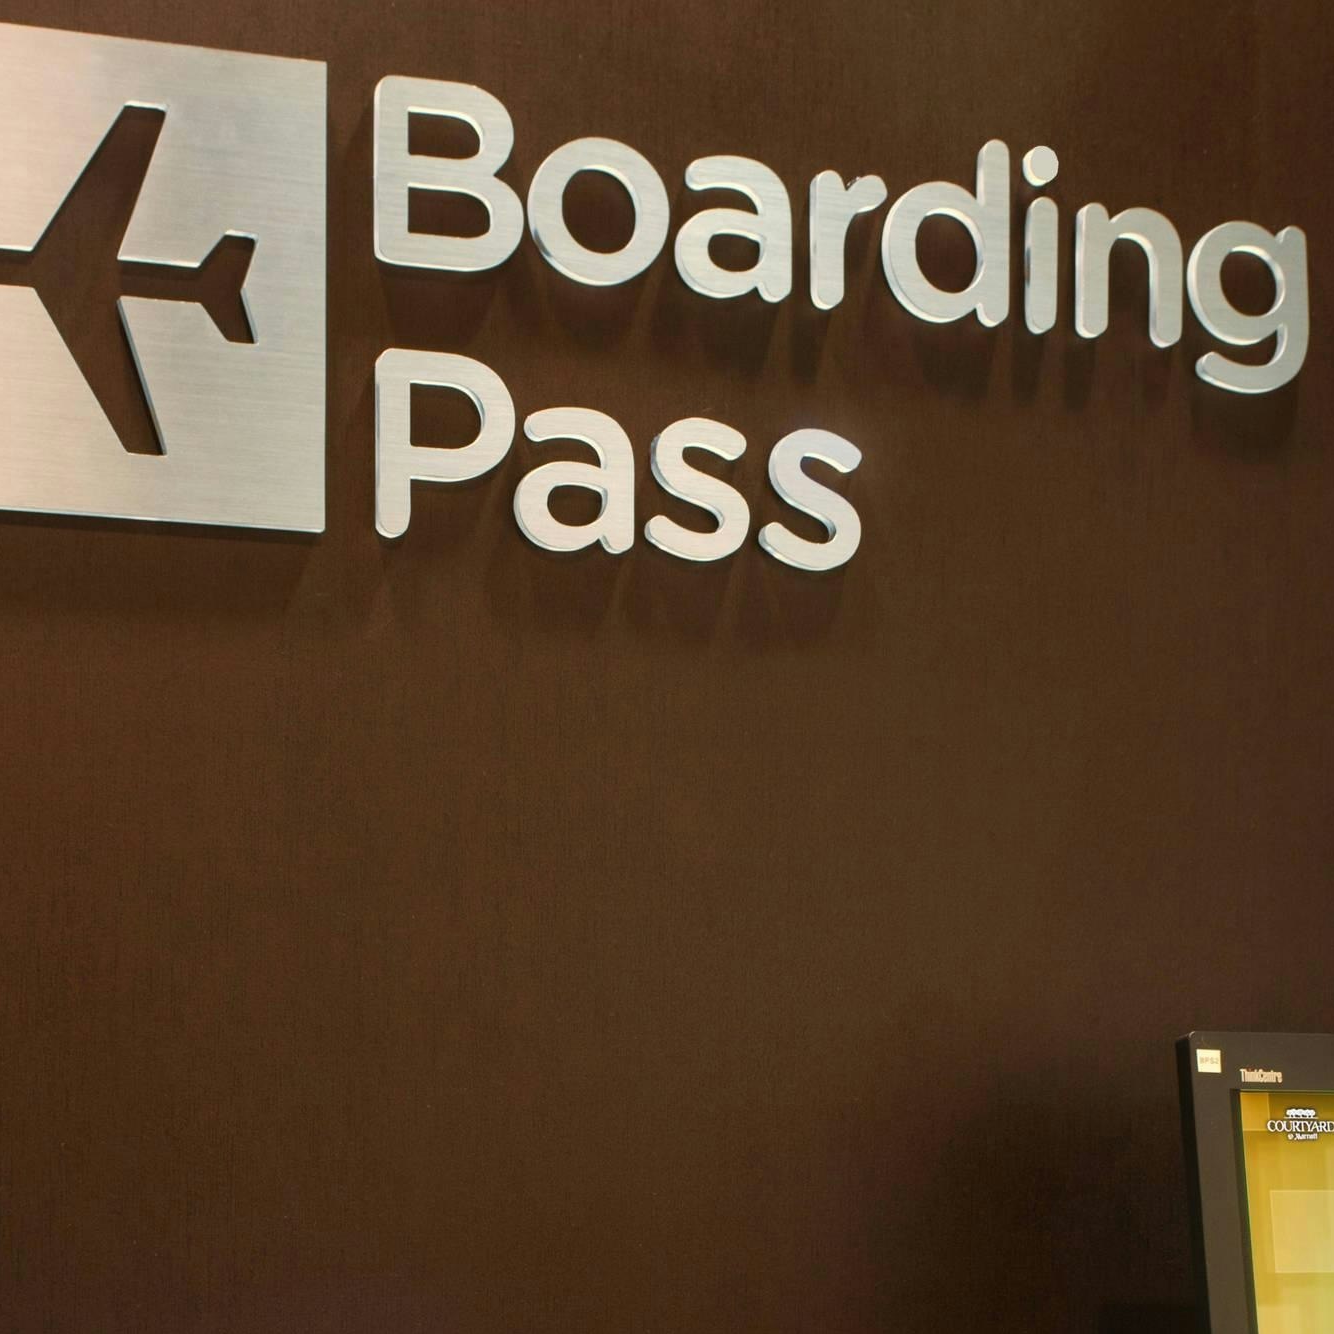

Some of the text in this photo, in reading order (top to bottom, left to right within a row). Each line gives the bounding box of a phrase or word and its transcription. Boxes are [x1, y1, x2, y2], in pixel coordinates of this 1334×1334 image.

[373, 74, 1310, 393] Boarding
[373, 347, 862, 571] Pass
[1239, 1068, 1283, 1083] ThinkCentre
